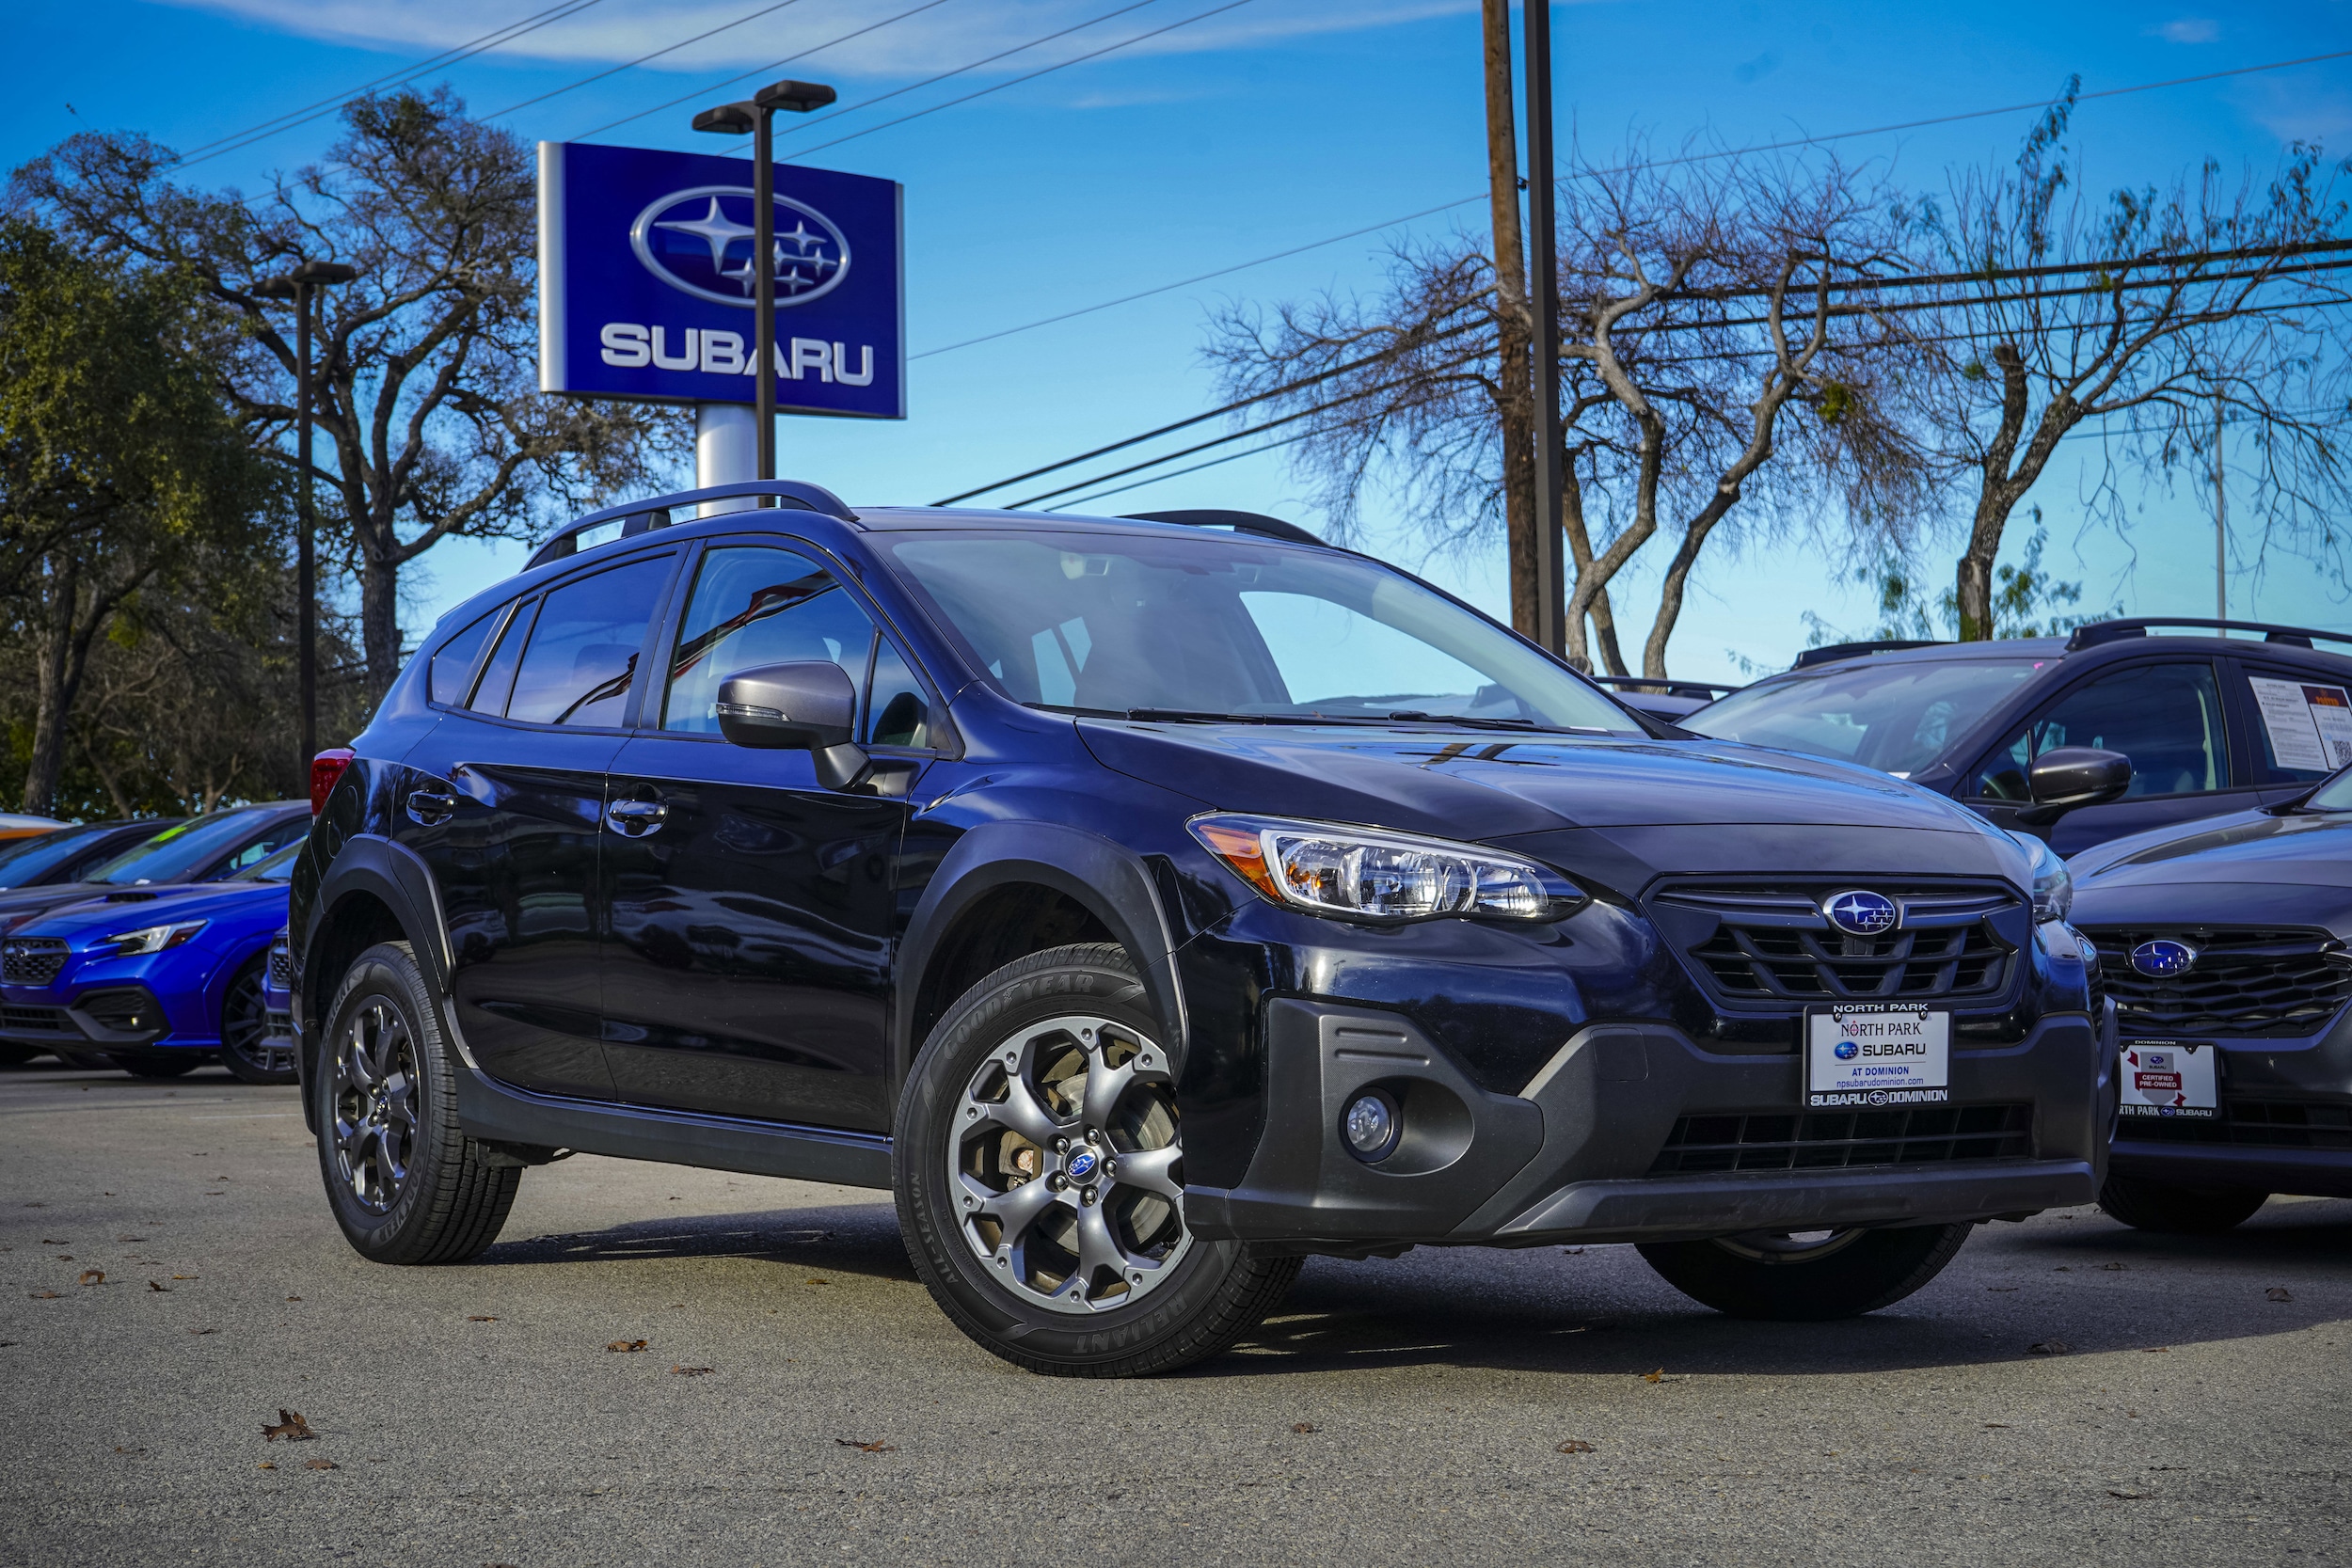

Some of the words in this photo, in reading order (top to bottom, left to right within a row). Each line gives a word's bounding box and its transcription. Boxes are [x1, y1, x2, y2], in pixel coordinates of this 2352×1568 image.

[599, 322, 875, 388] SUBARU
[1834, 1005, 1884, 1013] NORTH
[1890, 1003, 1929, 1011] PARK
[1841, 1022, 1883, 1037] NORTH
[1888, 1022, 1922, 1036] PARK
[1862, 1043, 1927, 1056] SUBARU
[1851, 1068, 1863, 1077] AT
[1866, 1066, 1909, 1076] DOMINION
[1836, 1077, 1924, 1090] npsubarudominion.com
[2139, 1080, 2177, 1088] PRE-OWNED
[1810, 1092, 1868, 1107] SUBARU
[1888, 1089, 1948, 1103] DOMINION
[2119, 1105, 2135, 1116] RTH
[2137, 1105, 2160, 1117] PARK
[2176, 1108, 2213, 1117] SUBARU
[910, 1172, 959, 1285] ALL-SEASON
